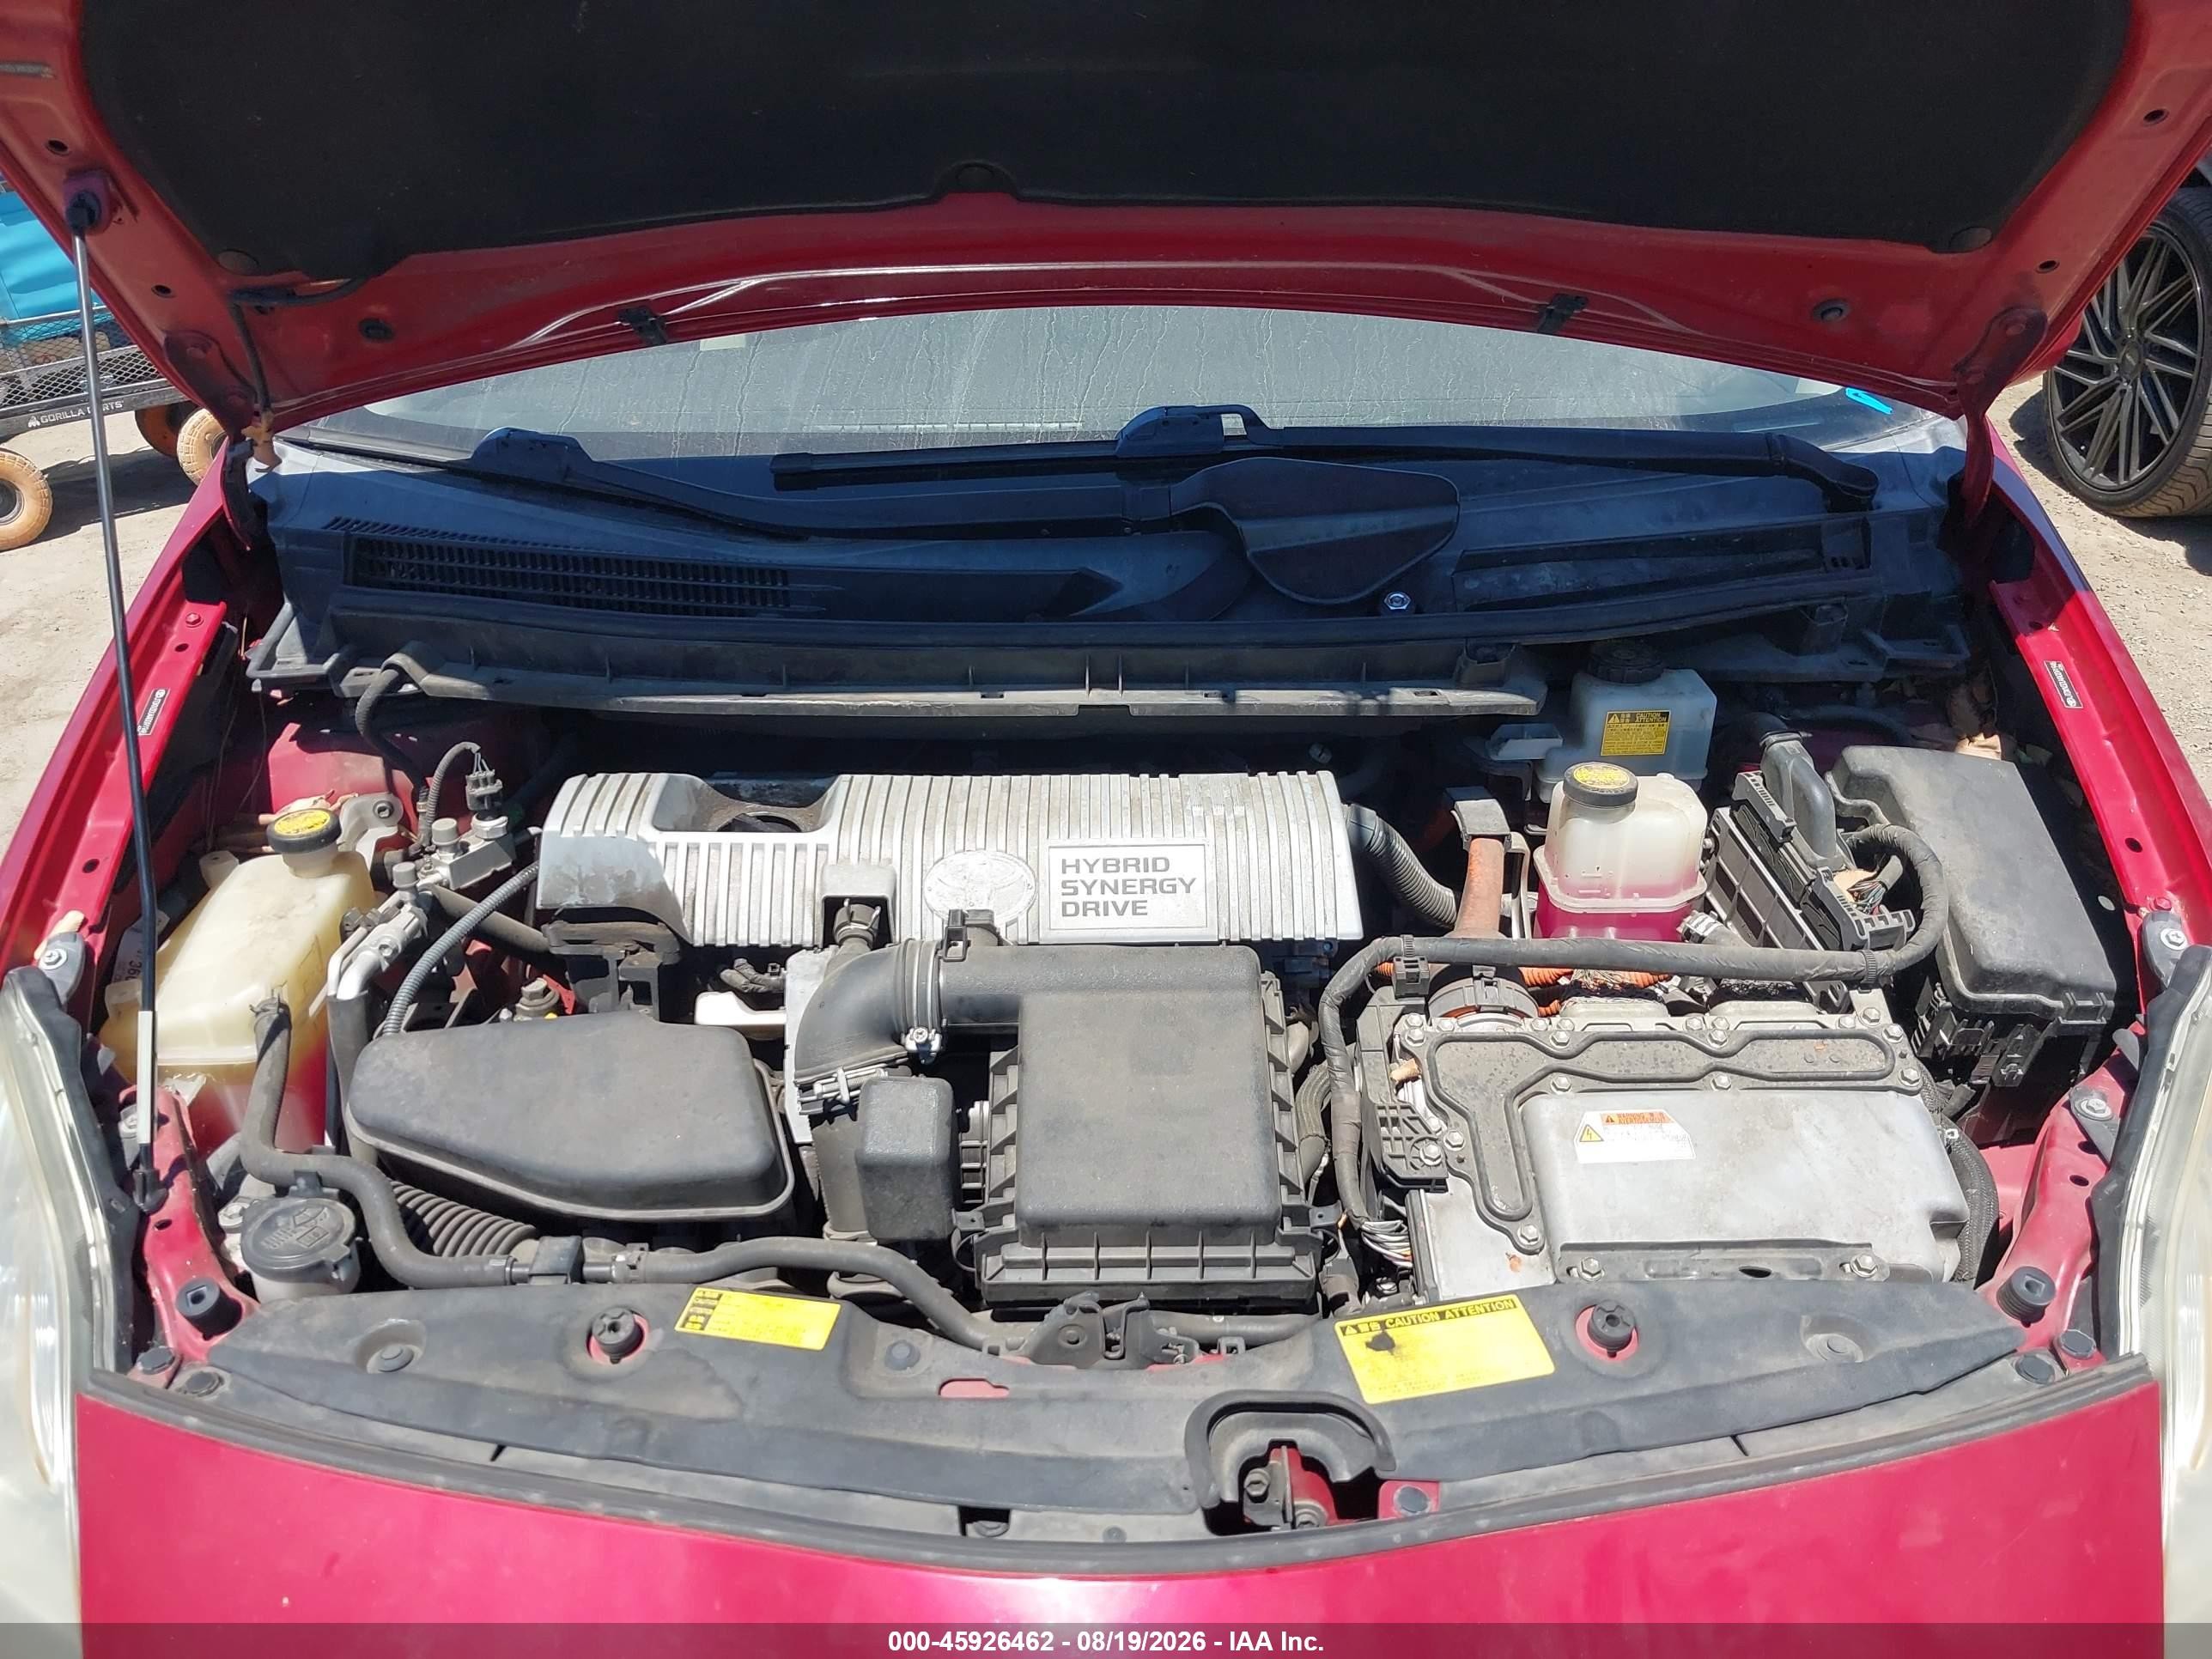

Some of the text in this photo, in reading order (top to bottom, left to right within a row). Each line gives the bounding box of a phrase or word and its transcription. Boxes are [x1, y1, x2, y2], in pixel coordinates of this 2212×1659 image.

[40, 408, 85, 423] GORILLA
[1061, 857, 1170, 874] HYBRID
[1061, 877, 1196, 896] SYNERGY
[1061, 900, 1148, 917] DRIVE
[1384, 1311, 1440, 1328] CAUTION
[1444, 1299, 1515, 1320] ATTENTION
